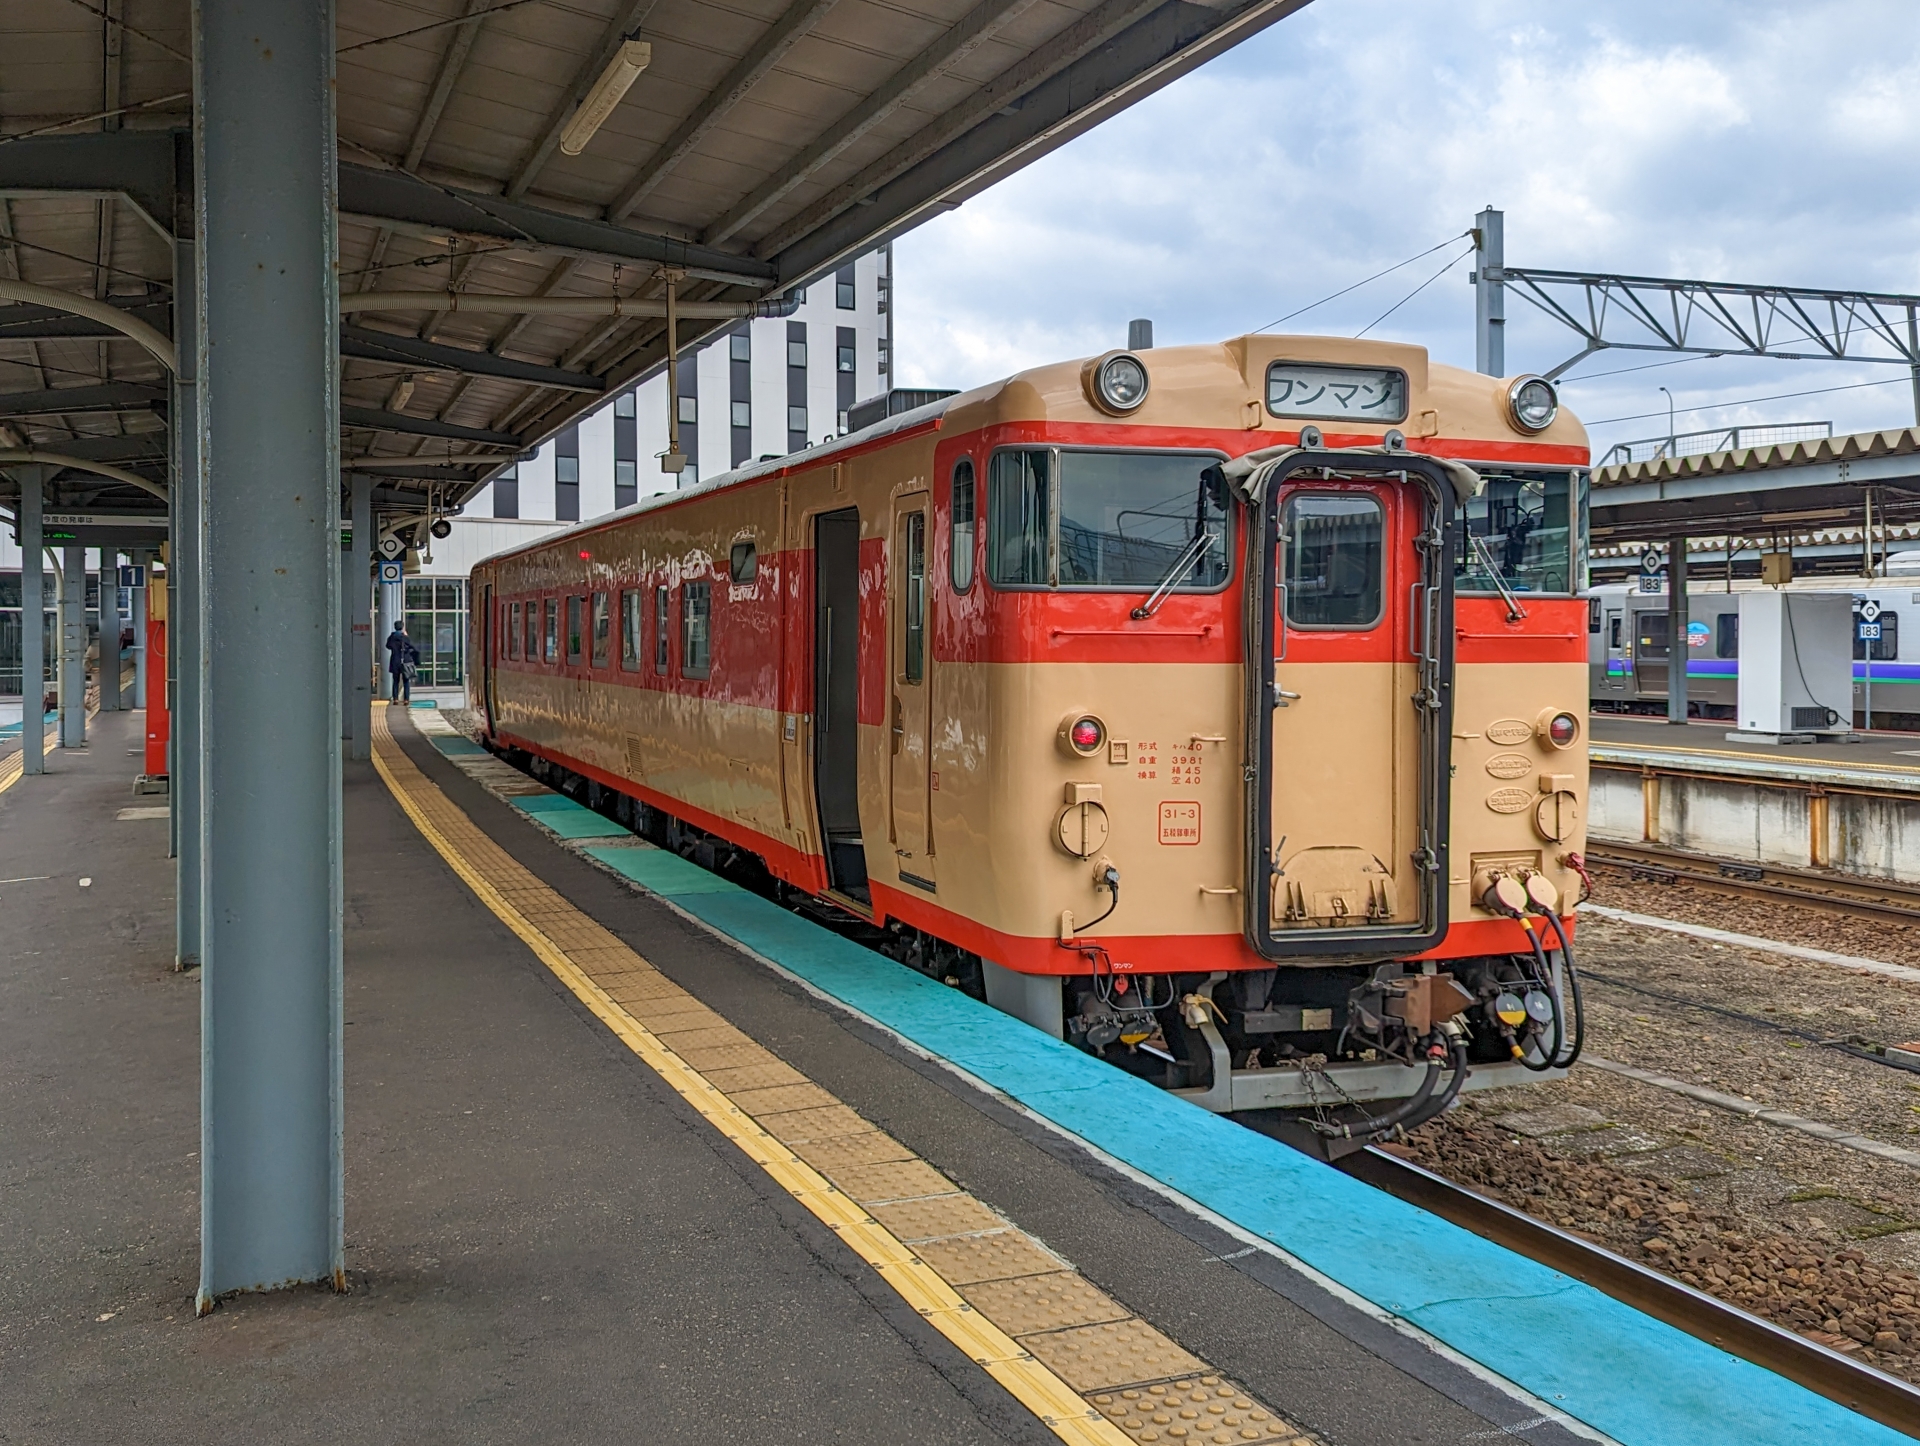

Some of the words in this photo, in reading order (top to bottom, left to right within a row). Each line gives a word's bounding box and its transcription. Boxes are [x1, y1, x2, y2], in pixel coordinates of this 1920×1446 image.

[128, 567, 136, 585] 1
[1641, 577, 1660, 590] 183
[1861, 626, 1879, 637] 183
[1137, 741, 1158, 751] 形式
[1138, 756, 1158, 765] 自重
[1113, 962, 1134, 970] ワンマン
